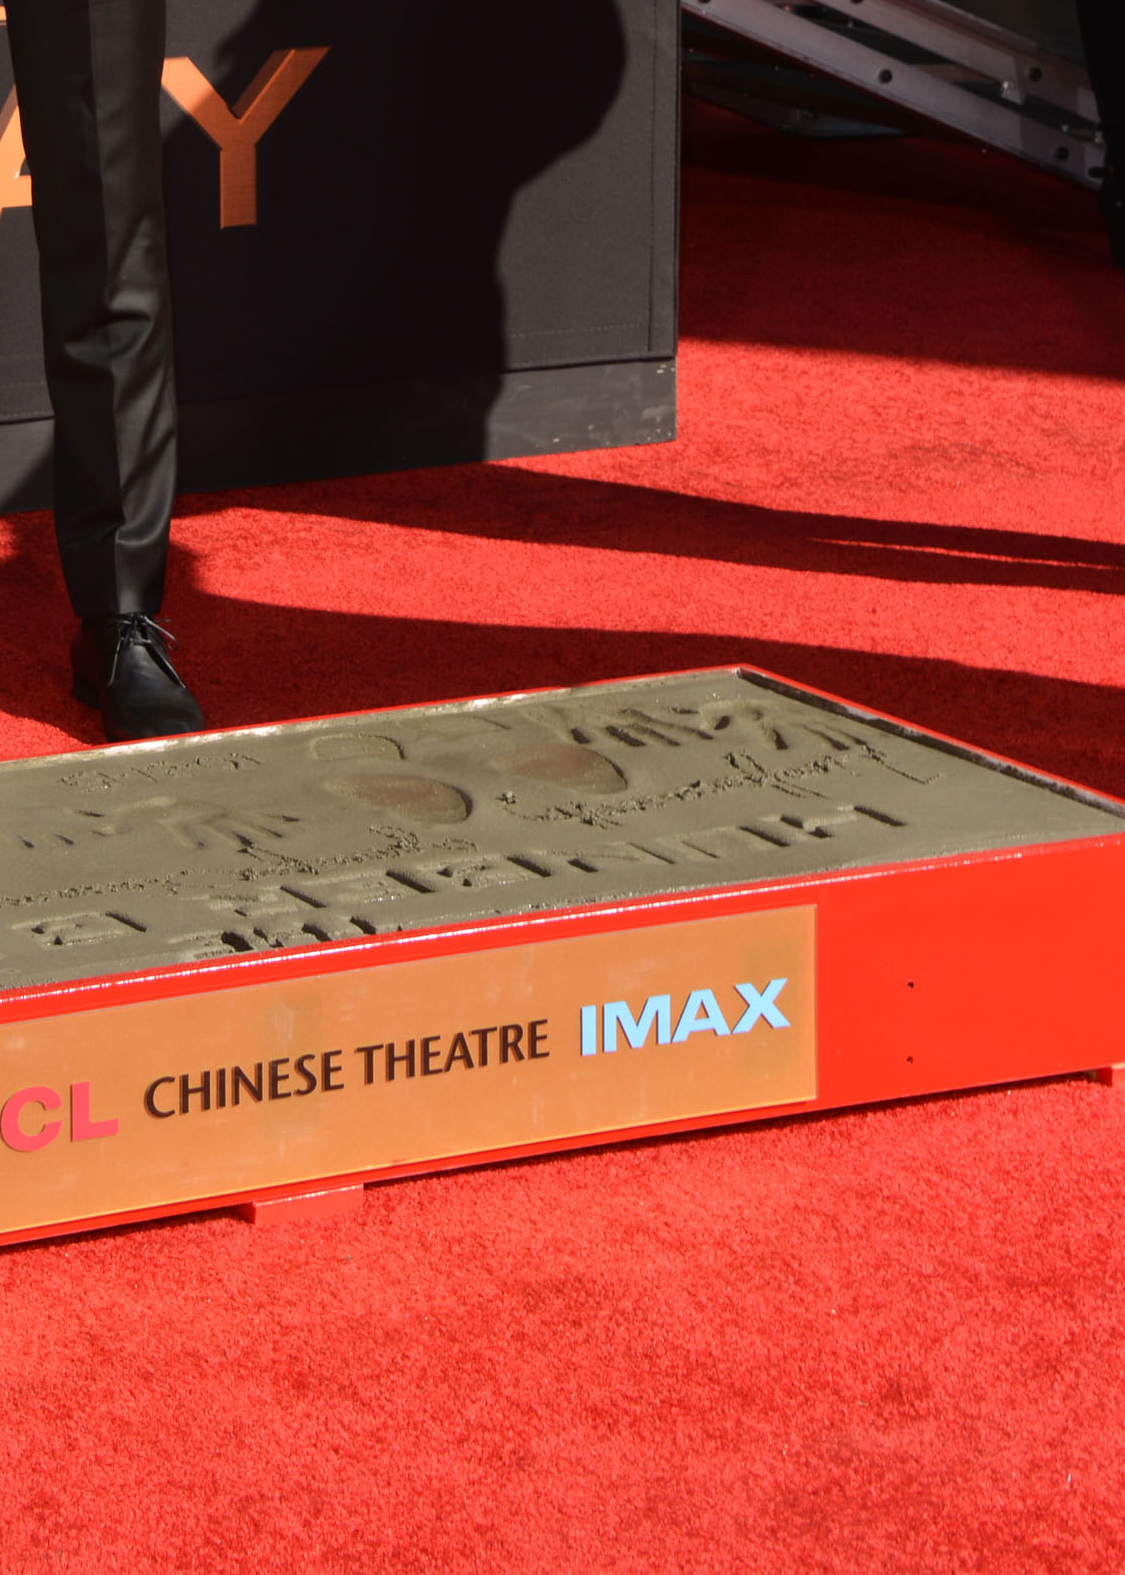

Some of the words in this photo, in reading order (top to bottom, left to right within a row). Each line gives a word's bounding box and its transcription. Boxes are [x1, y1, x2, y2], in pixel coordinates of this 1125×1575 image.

[143, 1049, 345, 1119] CHINESE
[355, 1018, 551, 1087] THEATRE
[579, 977, 792, 1057] IMAX
